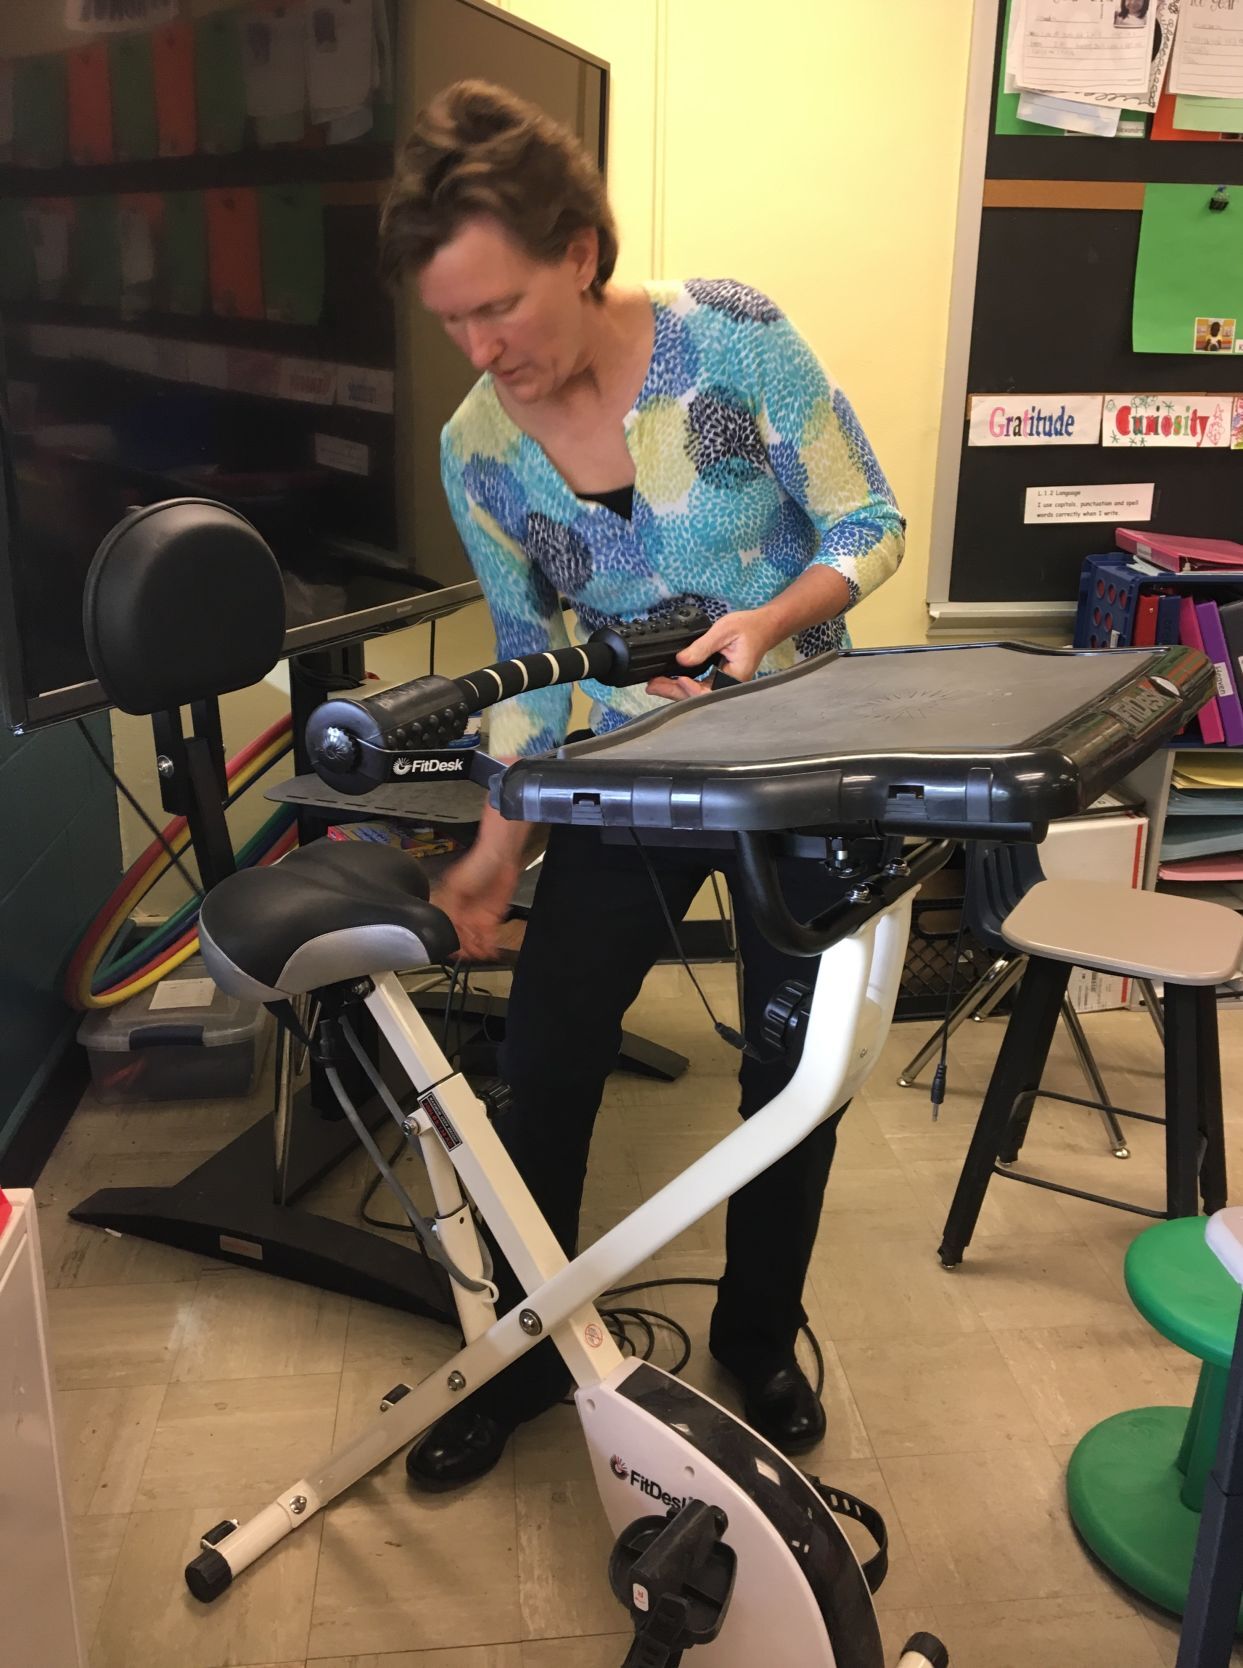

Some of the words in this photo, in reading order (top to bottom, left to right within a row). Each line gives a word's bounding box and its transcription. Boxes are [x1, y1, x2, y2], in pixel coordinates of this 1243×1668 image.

[989, 405, 1075, 437] Gratitude
[1115, 404, 1210, 447] Curiosity
[1080, 500, 1112, 508] punctuation
[411, 758, 464, 772] FitDesk
